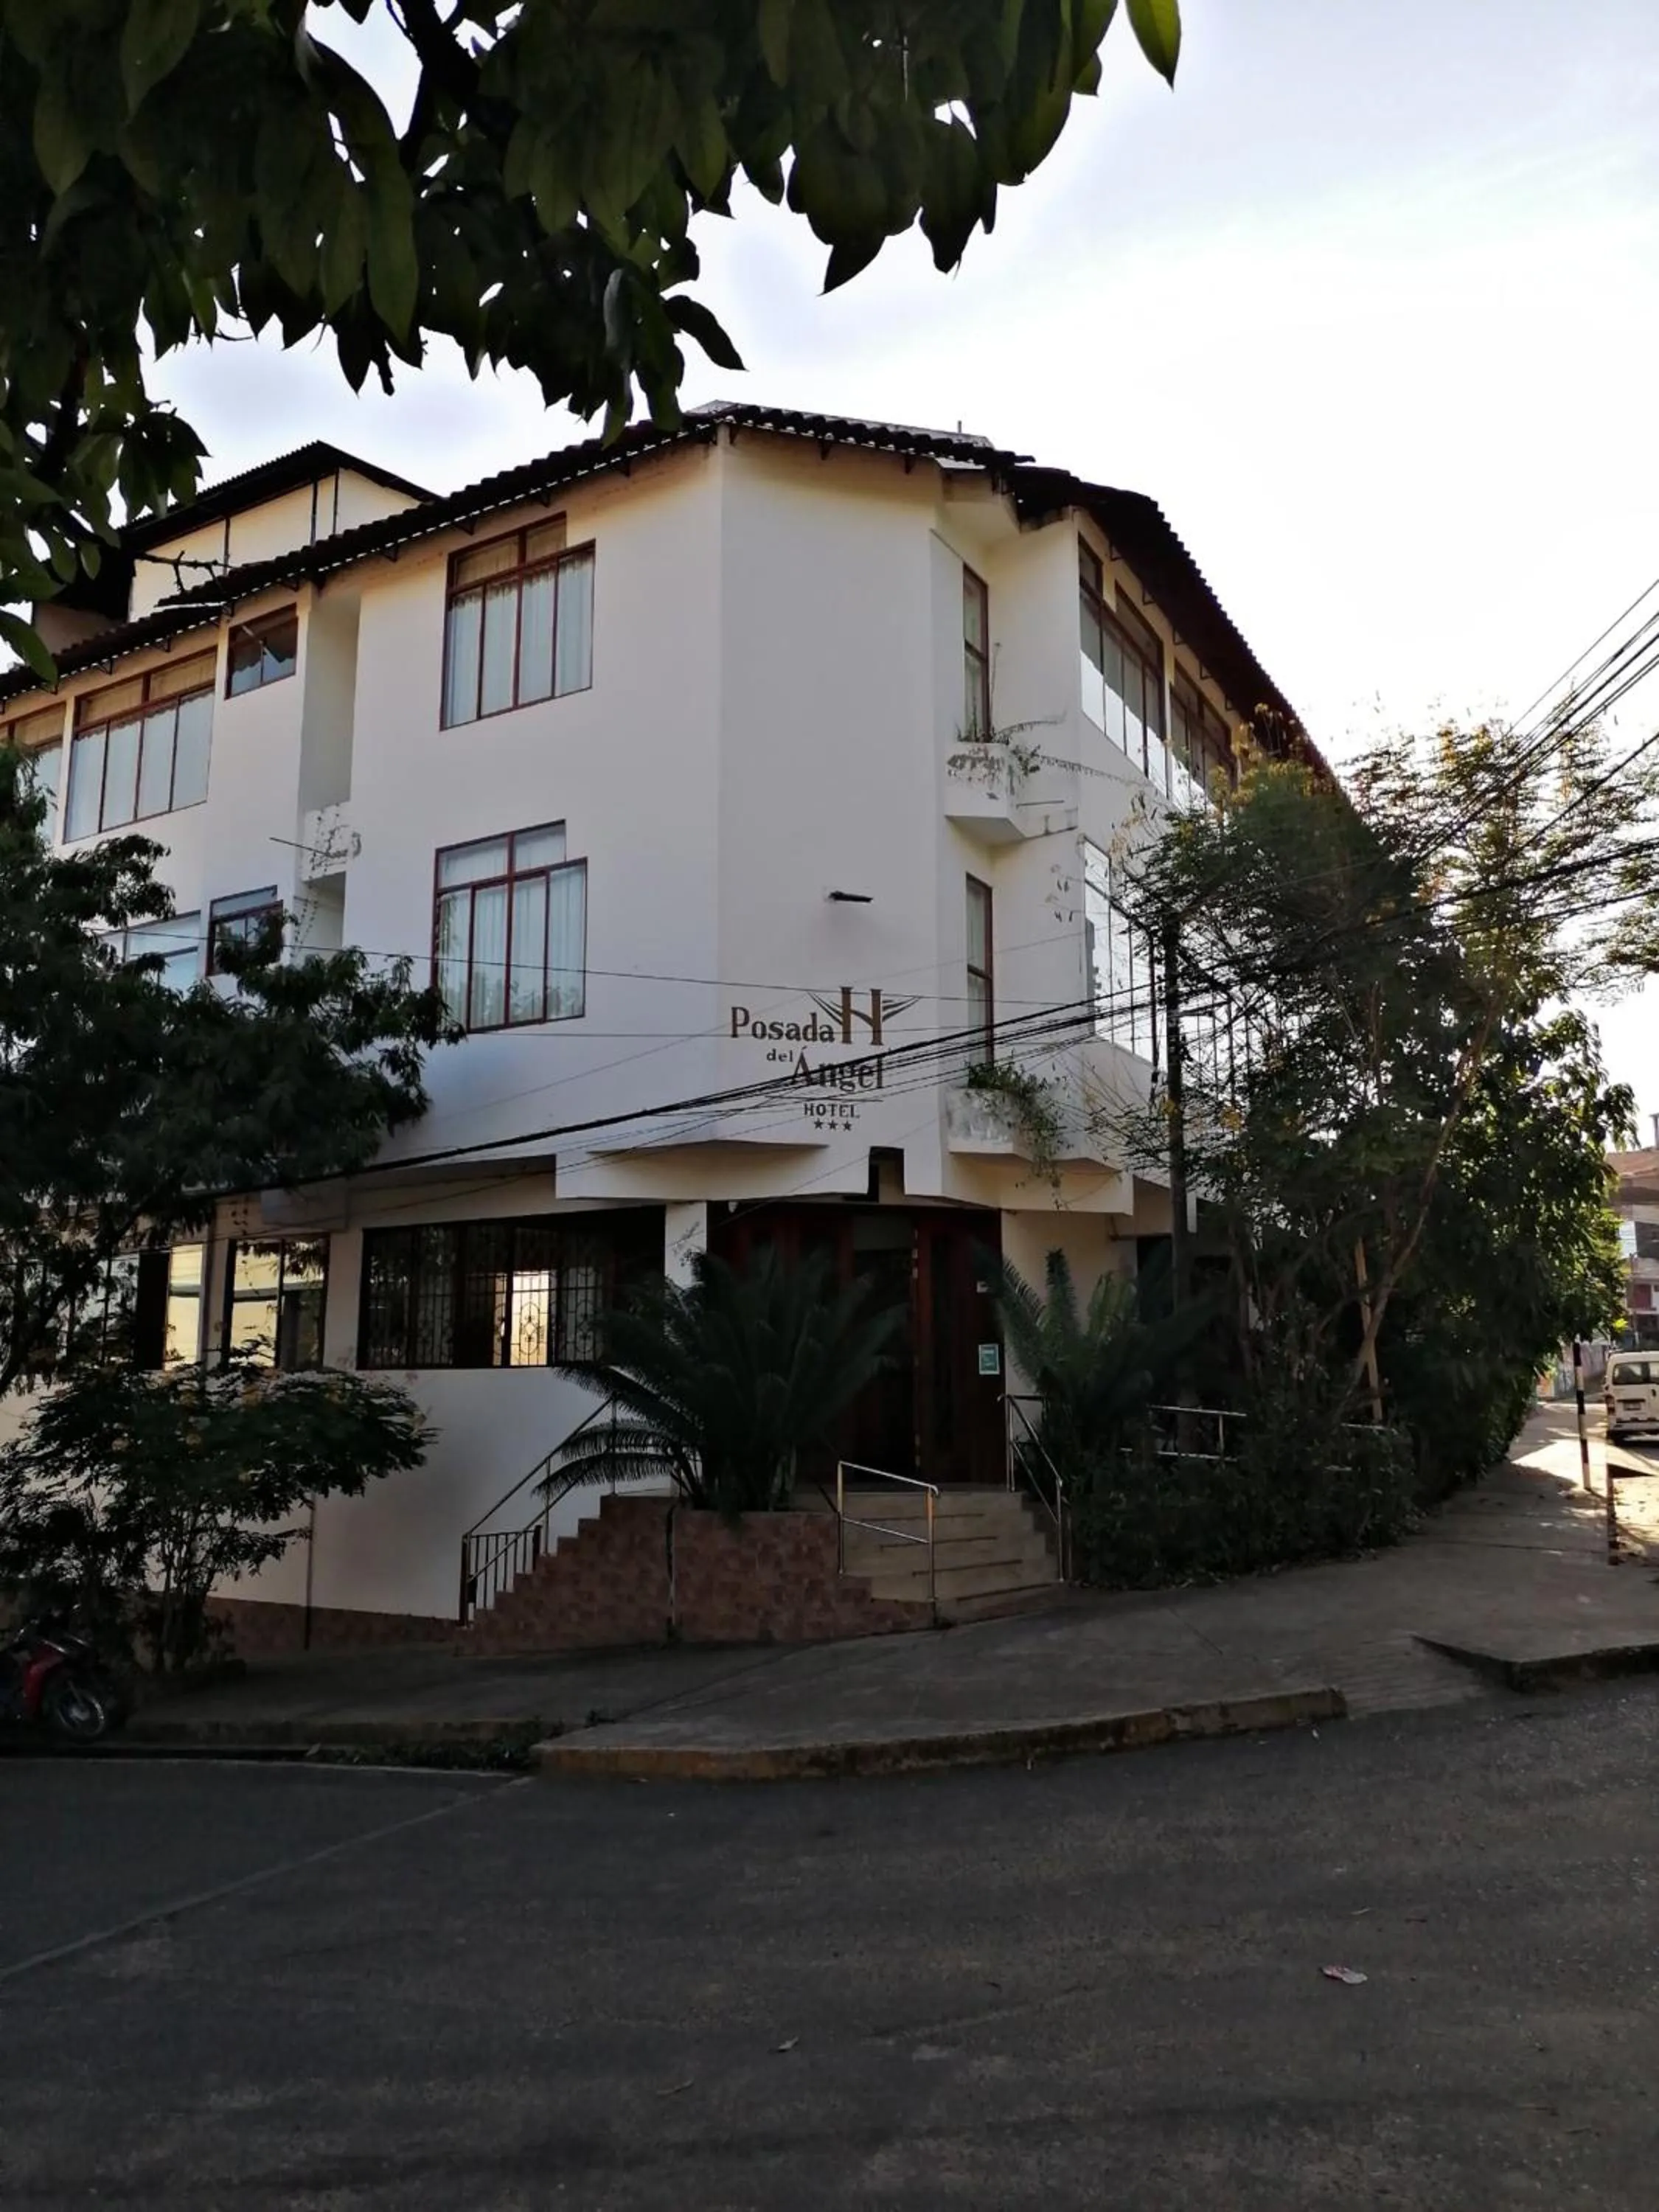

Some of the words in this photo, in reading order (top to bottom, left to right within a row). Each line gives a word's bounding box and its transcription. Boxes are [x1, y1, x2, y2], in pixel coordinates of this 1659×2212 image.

[731, 1006, 835, 1043] Posada
[767, 1048, 793, 1062] del
[804, 1103, 860, 1119] HOTEL
